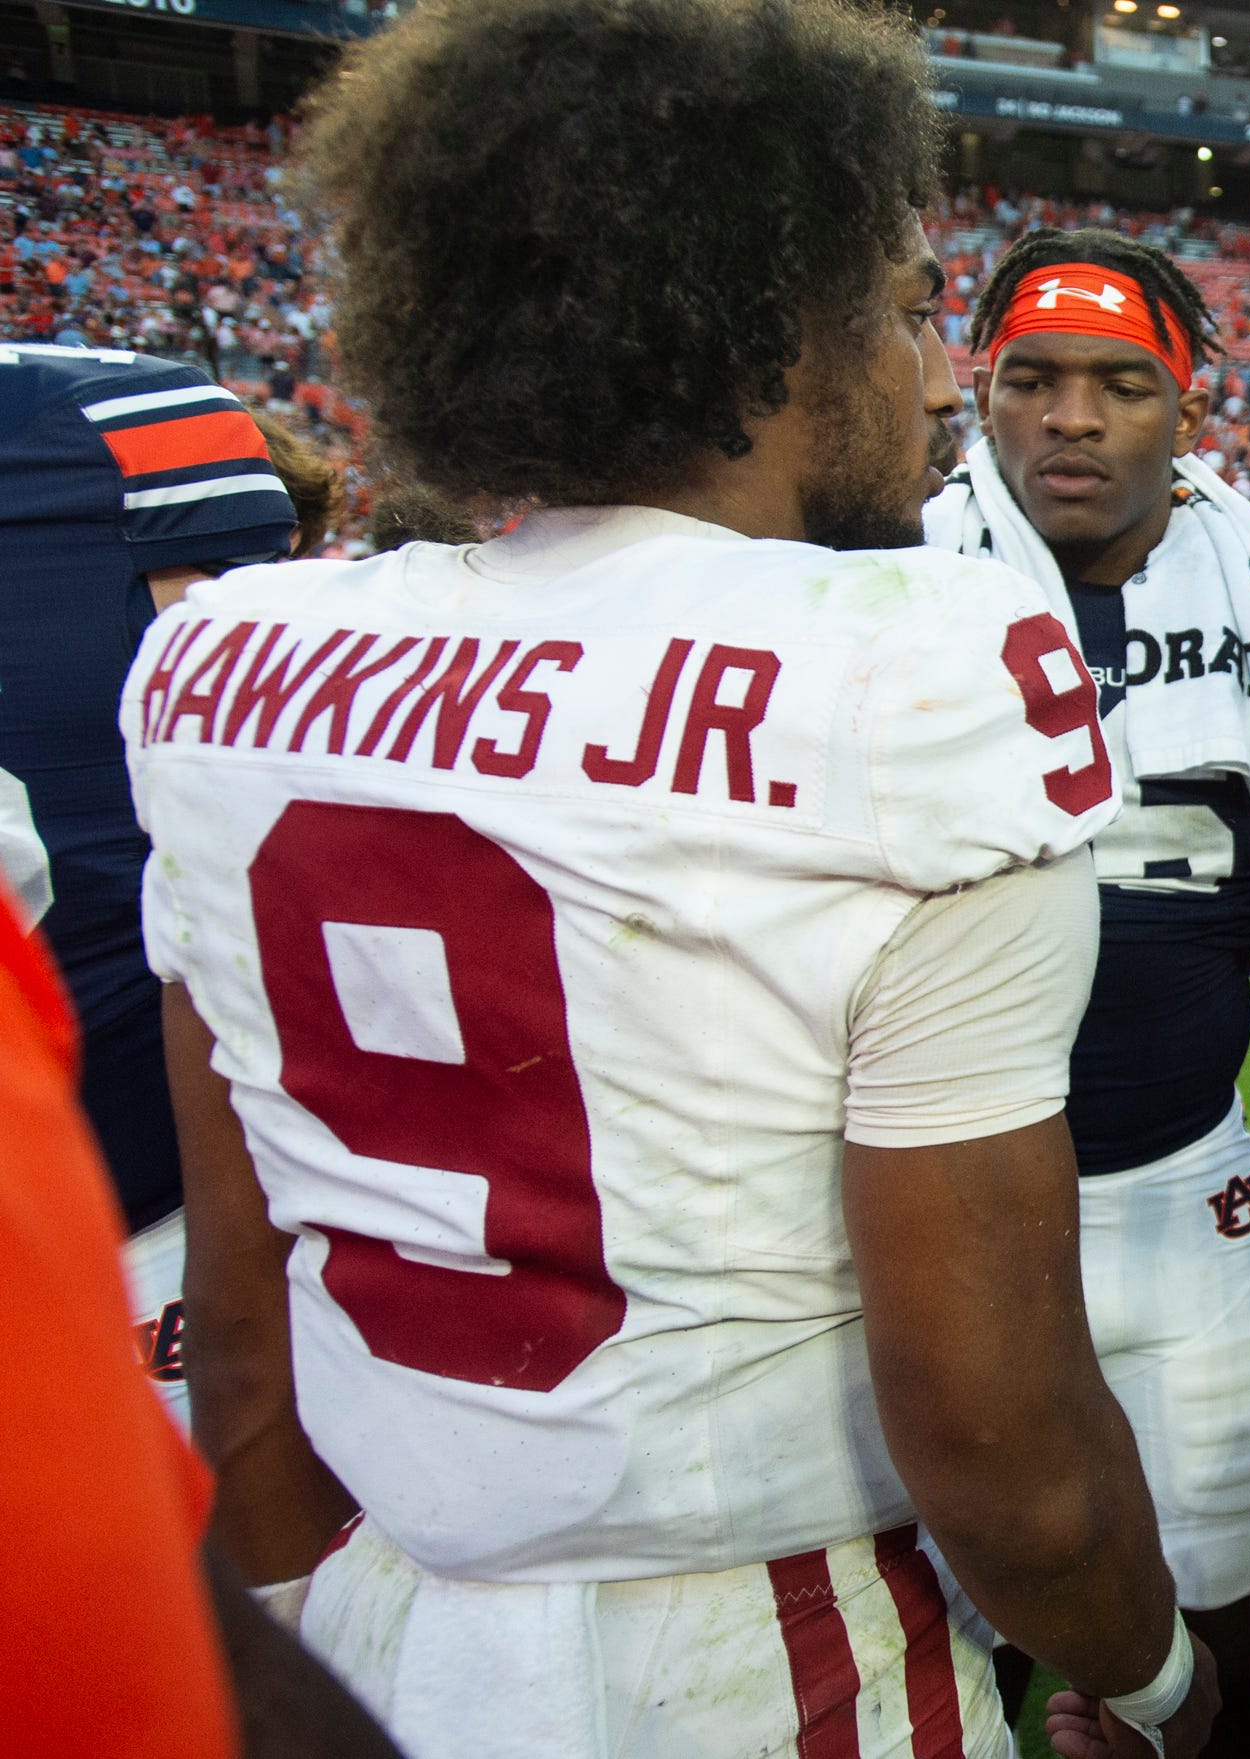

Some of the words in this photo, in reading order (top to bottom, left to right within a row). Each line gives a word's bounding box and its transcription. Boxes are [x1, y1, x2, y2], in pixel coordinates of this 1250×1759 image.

[142, 618, 585, 778] HAWKINS
[582, 638, 797, 808] JR.
[1001, 612, 1112, 817] 9
[249, 799, 626, 1392] 9
